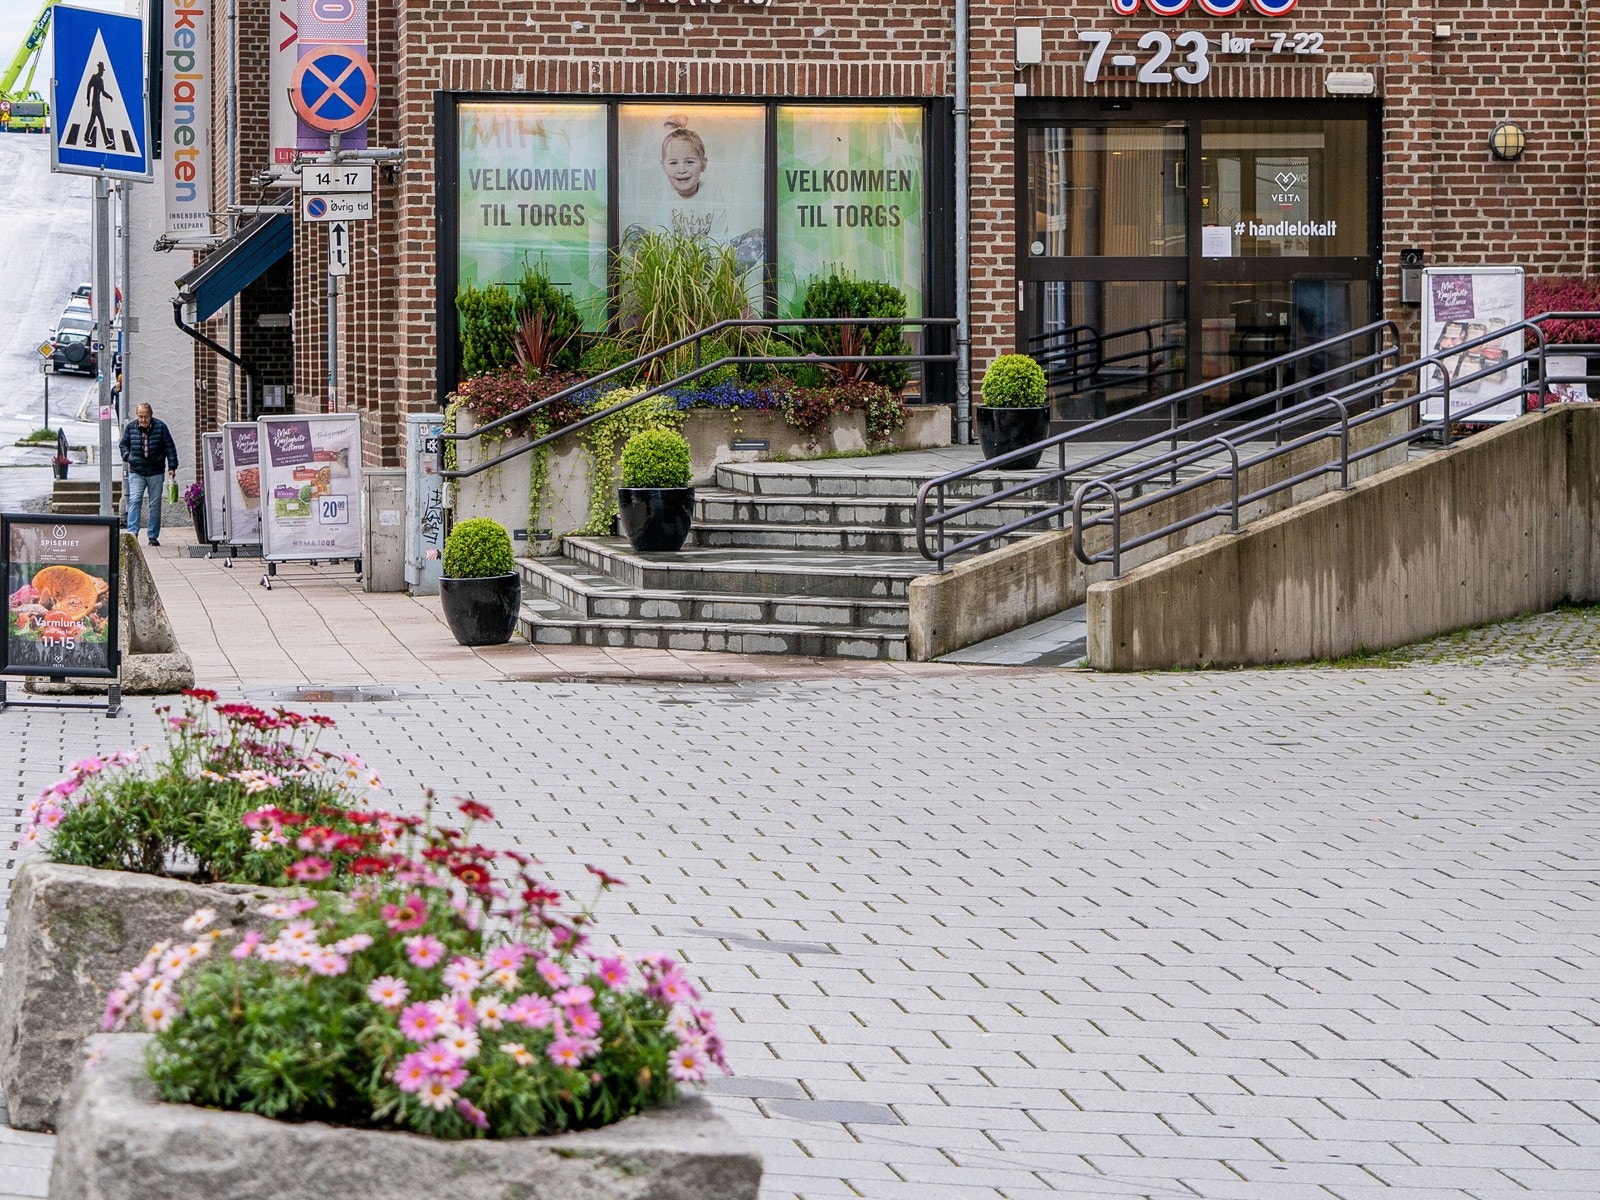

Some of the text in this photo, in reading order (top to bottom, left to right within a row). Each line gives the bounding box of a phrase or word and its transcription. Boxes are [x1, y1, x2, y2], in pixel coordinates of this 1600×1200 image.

[1079, 31, 1211, 85] 7-23
[1270, 32, 1325, 54] 7-22
[316, 173, 331, 185] 14
[344, 173, 358, 185] 17
[468, 168, 597, 191] VELKOMMEN
[785, 169, 912, 193] VELKOMMEN
[1271, 194, 1300, 202] VEITA
[331, 202, 369, 212] Øvrig tid
[480, 203, 586, 227] TIL TORGS
[797, 204, 901, 228] TIL TORGS
[173, 222, 204, 230] LEKEPARK
[1249, 220, 1337, 236] handlelokalt
[323, 501, 337, 518] 20
[41, 539, 80, 547] SPISERIET
[42, 636, 75, 650] 11-15
